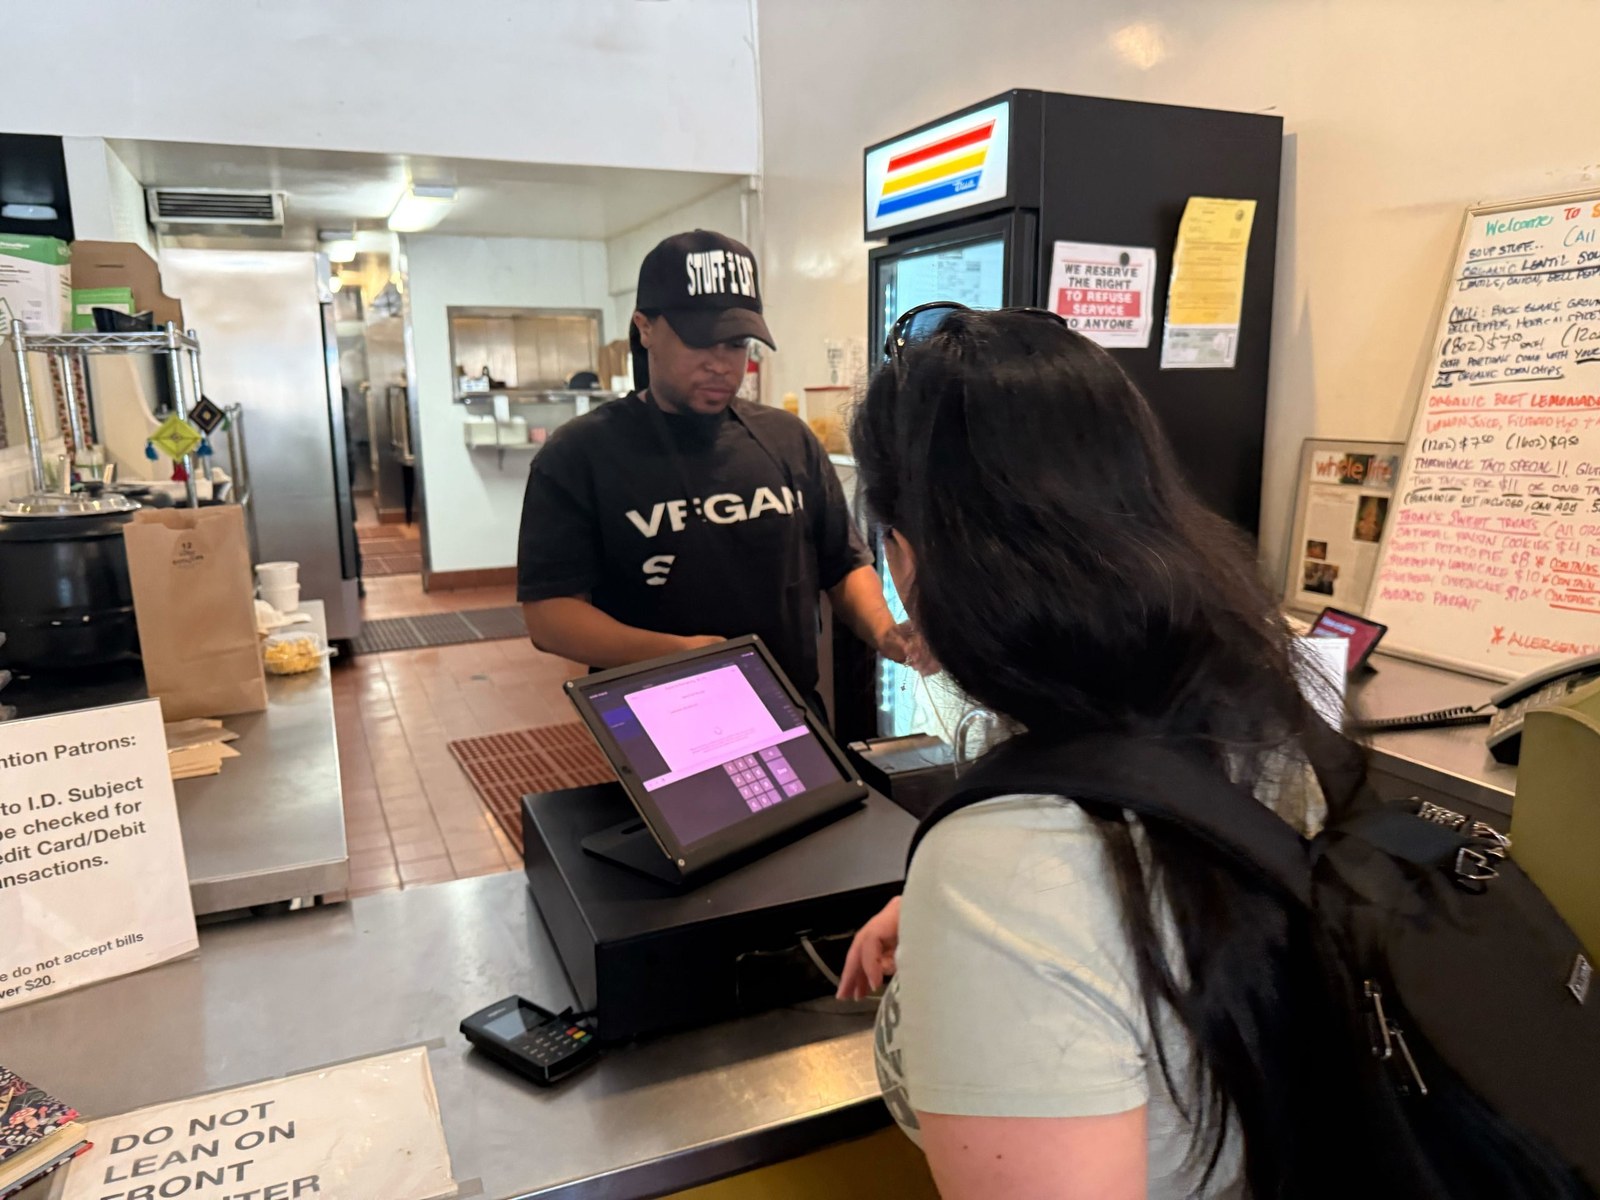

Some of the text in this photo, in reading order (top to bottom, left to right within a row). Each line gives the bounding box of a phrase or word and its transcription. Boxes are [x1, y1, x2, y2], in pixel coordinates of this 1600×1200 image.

[1485, 215, 1554, 236] Welcome
[686, 249, 726, 297] STUFF
[1065, 264, 1138, 278] WE RESERVE
[1069, 277, 1132, 290] THE RIGHT
[1065, 290, 1133, 304] TO REFUSE
[1072, 303, 1125, 316] SERVICE
[1083, 319, 1134, 329] ANYONE
[54, 735, 137, 759] Patrons:
[0, 777, 144, 816] to I.D. Subject
[23, 805, 110, 836] checked
[114, 801, 142, 816] for
[37, 821, 147, 856] Card/Debit
[0, 855, 109, 889] nsactions.
[12, 966, 32, 979] do
[36, 956, 61, 972] not
[64, 941, 113, 965] accept
[115, 933, 144, 948] bills
[24, 975, 56, 992] $20.
[110, 1100, 275, 1155] DO NOT
[103, 1120, 295, 1185] LEAN ON
